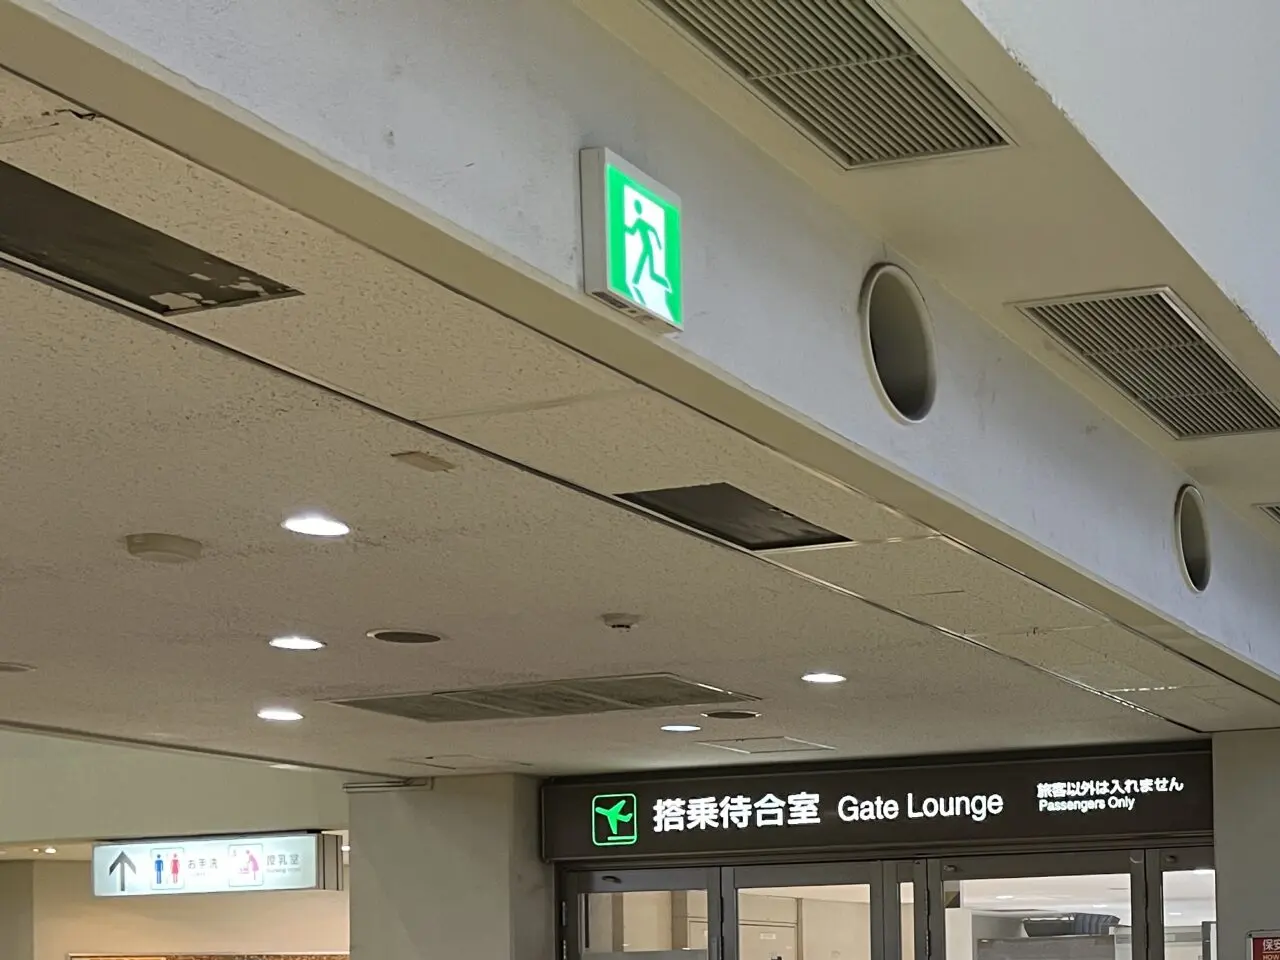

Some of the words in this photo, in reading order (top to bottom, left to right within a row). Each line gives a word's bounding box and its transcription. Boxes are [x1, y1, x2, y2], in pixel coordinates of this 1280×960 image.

[1036, 776, 1184, 799] 旅客以外は入れません
[653, 791, 821, 833] 搭乗待合室
[838, 794, 900, 822] Gate
[907, 791, 1004, 822] Lounge
[1038, 796, 1107, 814] Passengers
[1108, 795, 1136, 812] Only
